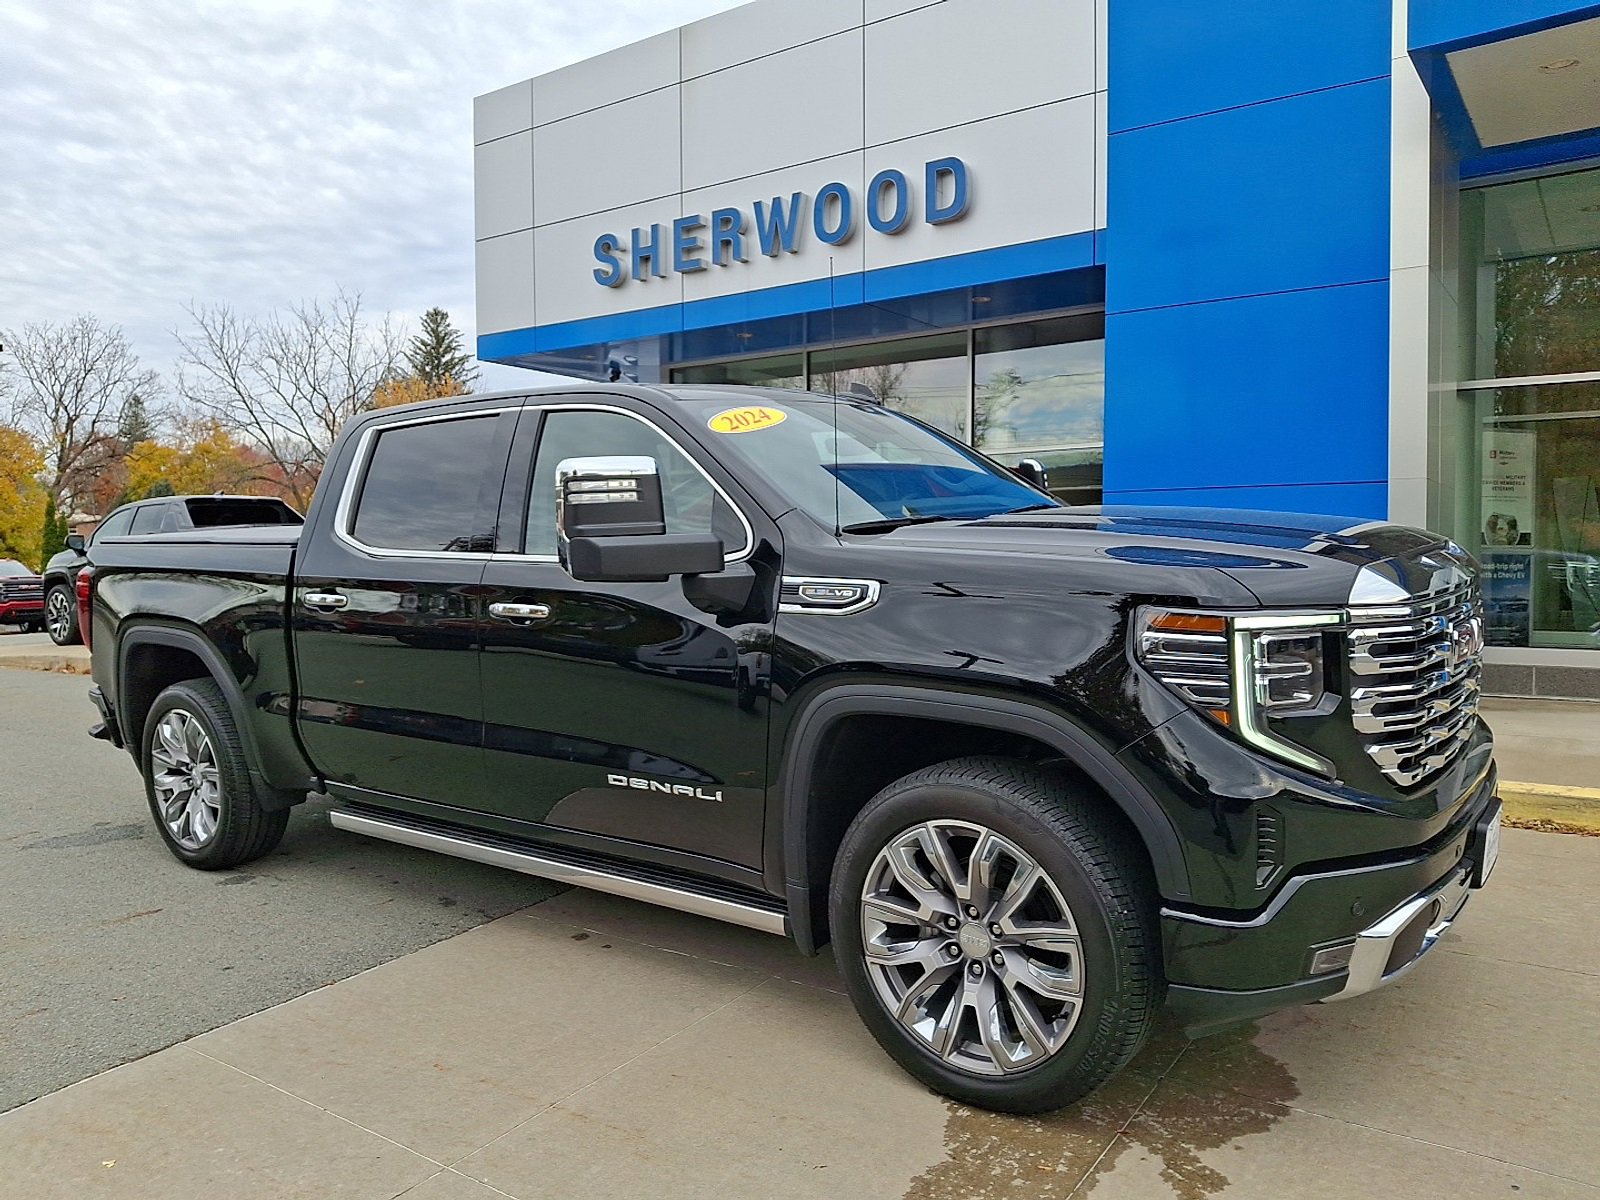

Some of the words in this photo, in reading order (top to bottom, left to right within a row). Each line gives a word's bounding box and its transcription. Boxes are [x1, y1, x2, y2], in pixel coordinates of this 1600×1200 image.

[593, 156, 971, 288] SHERWOOD
[721, 408, 771, 431] 2024
[1509, 562, 1524, 571] right
[1498, 571, 1516, 580] Chevy
[1517, 571, 1526, 579] EV
[834, 589, 854, 597] V8
[607, 774, 723, 802] DENALI
